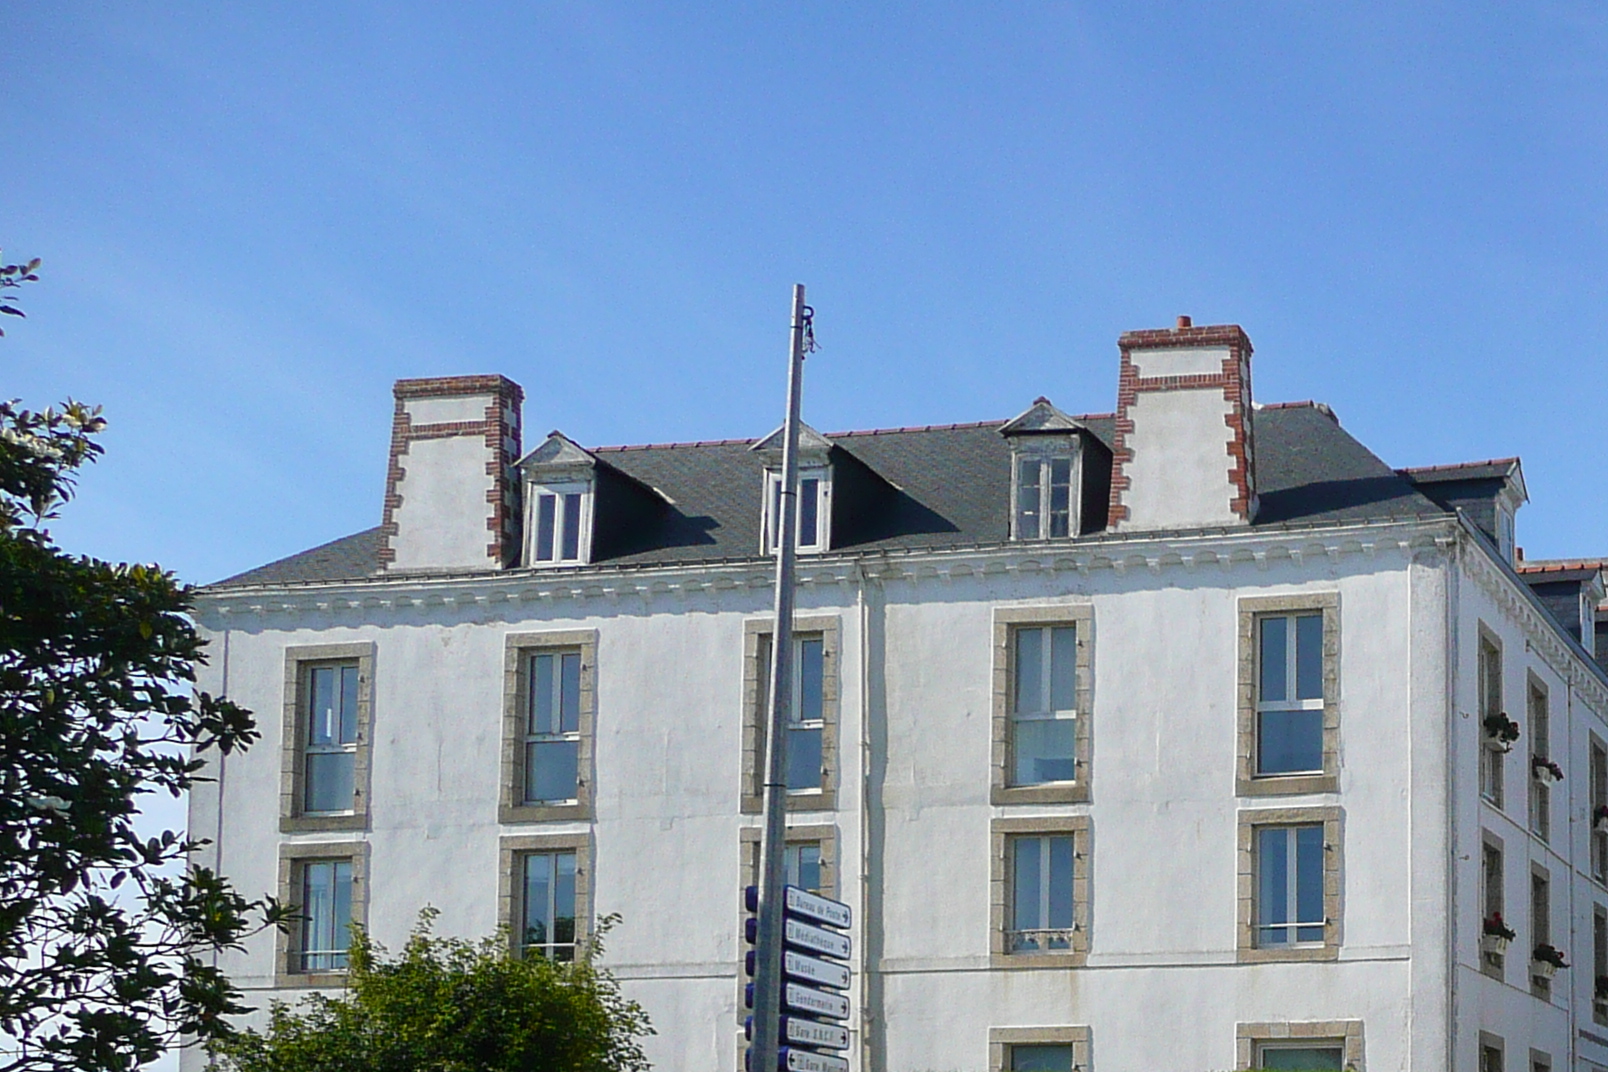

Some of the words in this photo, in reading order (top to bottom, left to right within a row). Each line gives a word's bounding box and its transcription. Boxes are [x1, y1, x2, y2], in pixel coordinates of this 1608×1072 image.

[826, 905, 840, 920] Poste
[796, 1025, 810, 1039] Gare
[806, 1058, 819, 1071] Gare
